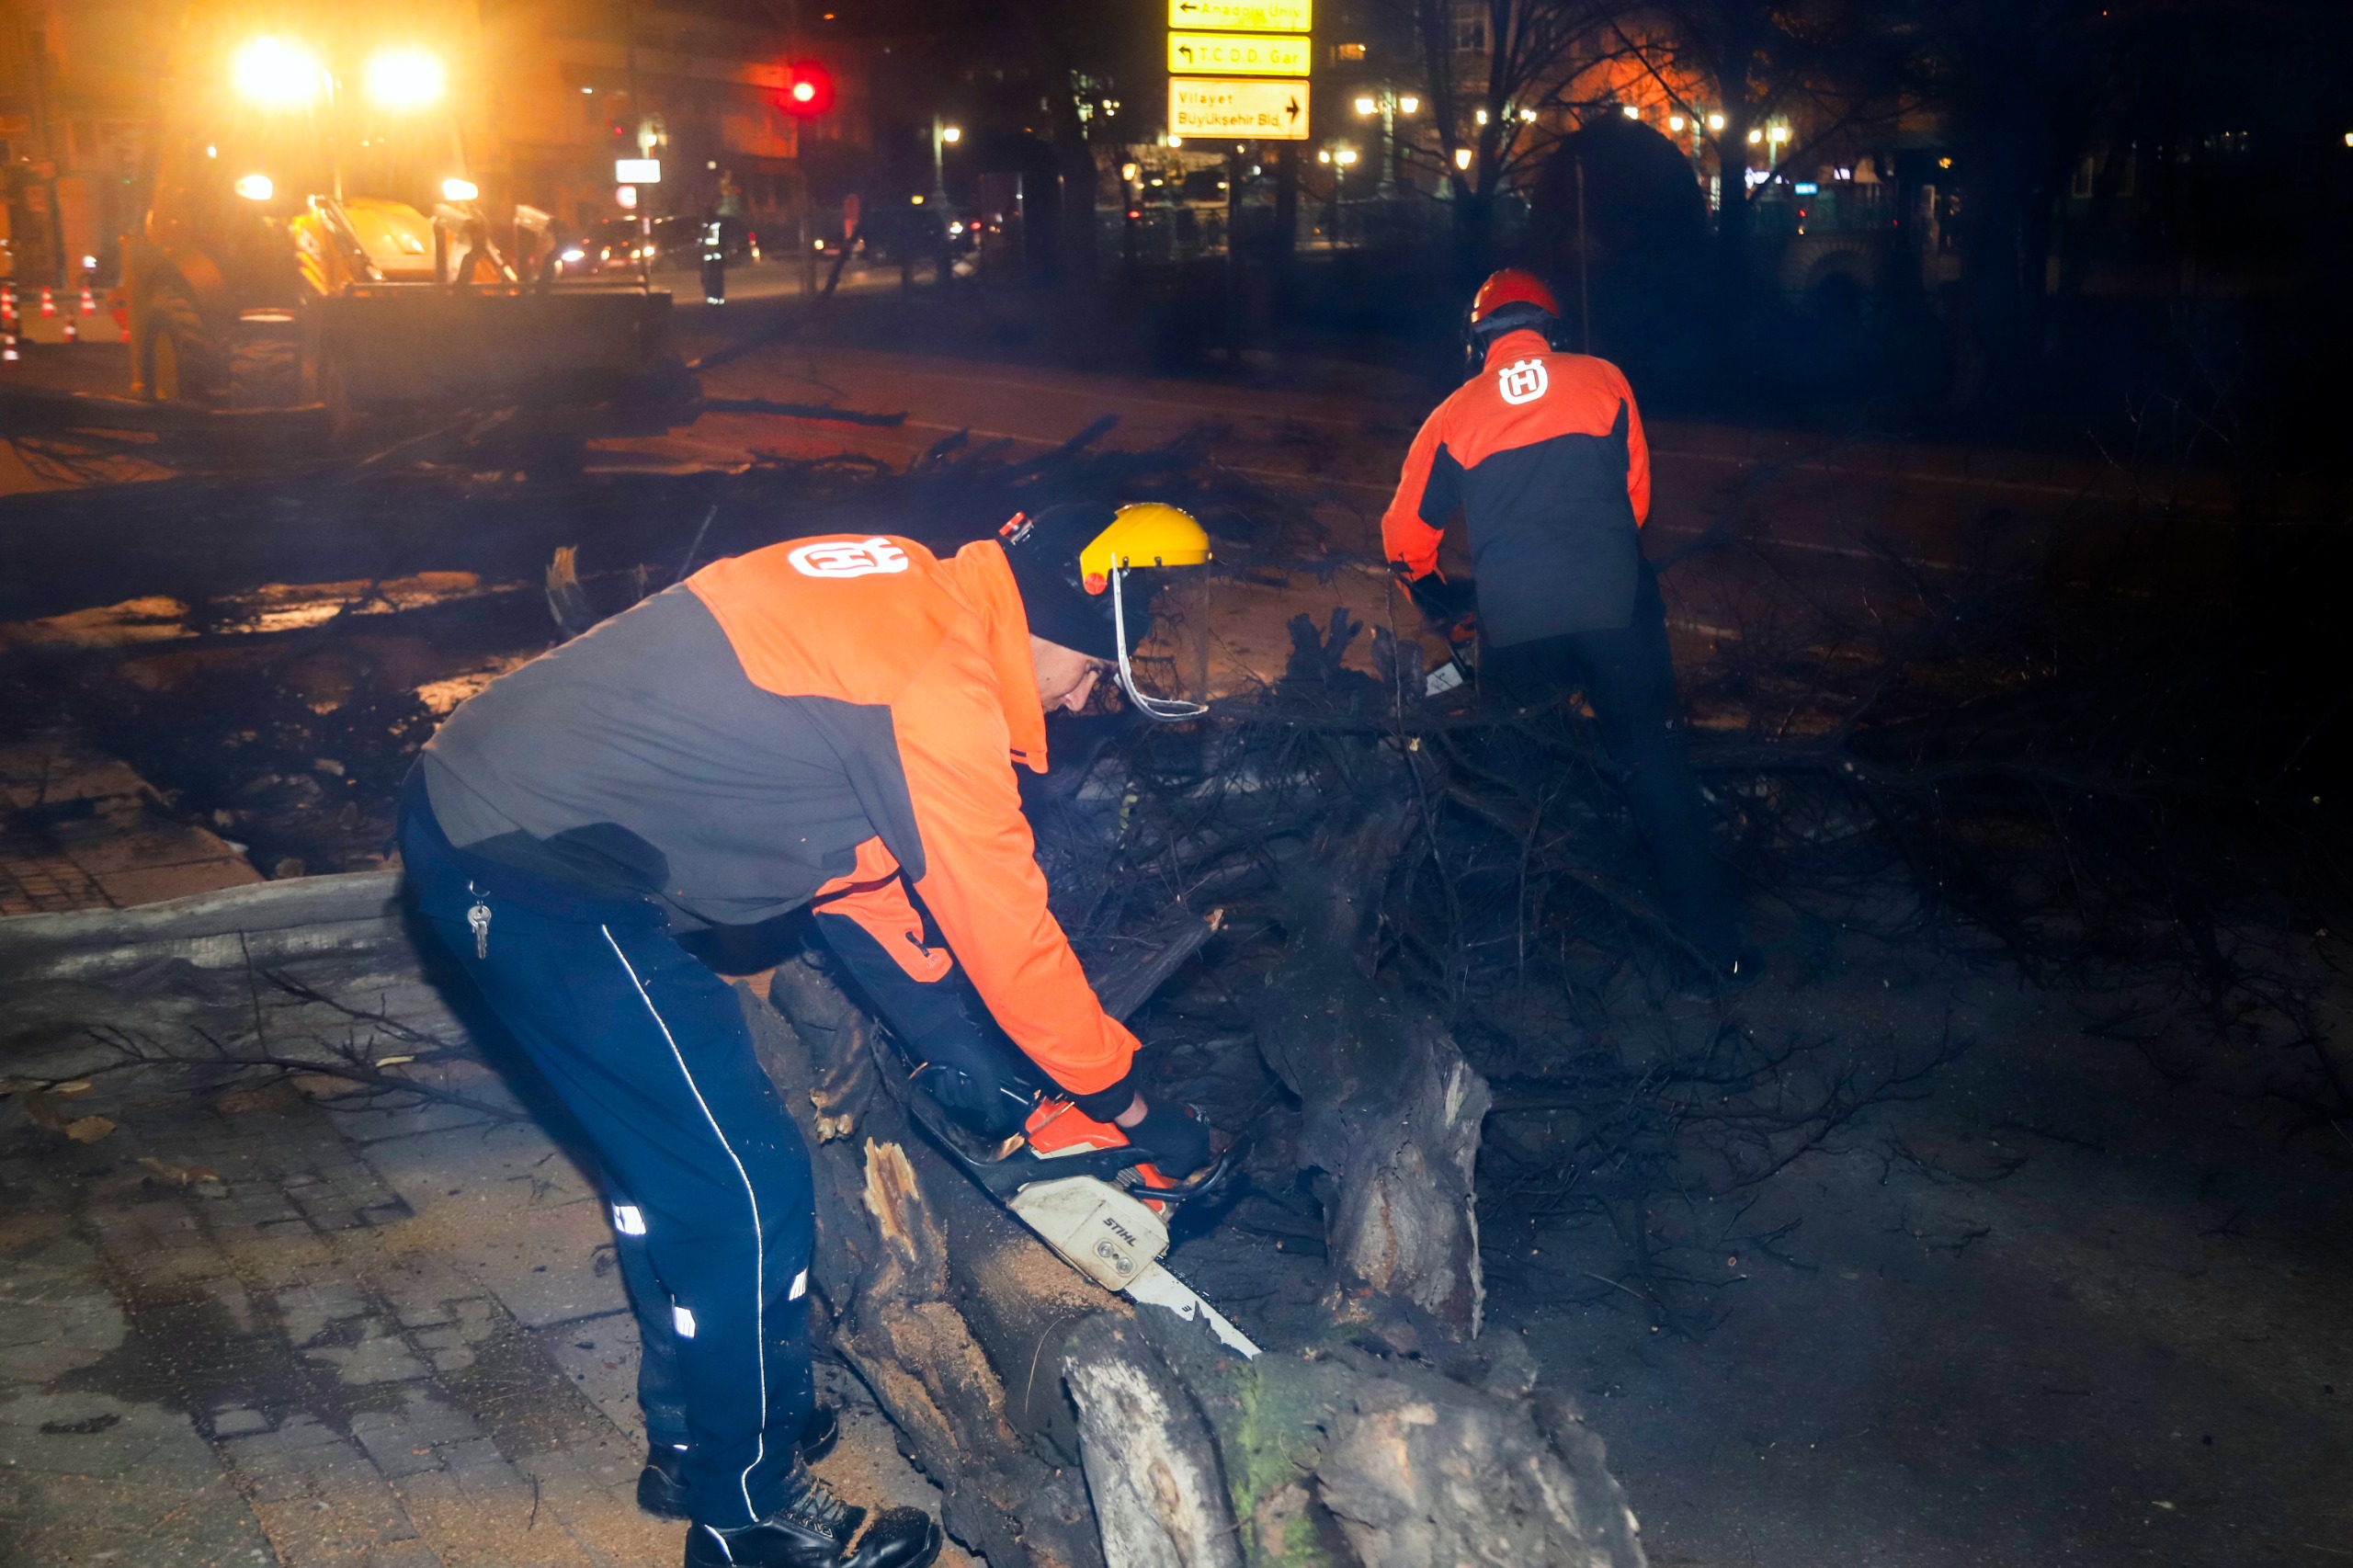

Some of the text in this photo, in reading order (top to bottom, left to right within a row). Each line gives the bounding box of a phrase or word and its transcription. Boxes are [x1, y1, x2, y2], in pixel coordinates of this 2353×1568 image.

[1201, 3, 1265, 17] Anadolu
[1270, 49, 1300, 64] Gar
[1178, 92, 1233, 108] Vilayet
[1178, 111, 1255, 129] Büyükşehir
[1103, 1217, 1137, 1247] STIHL
